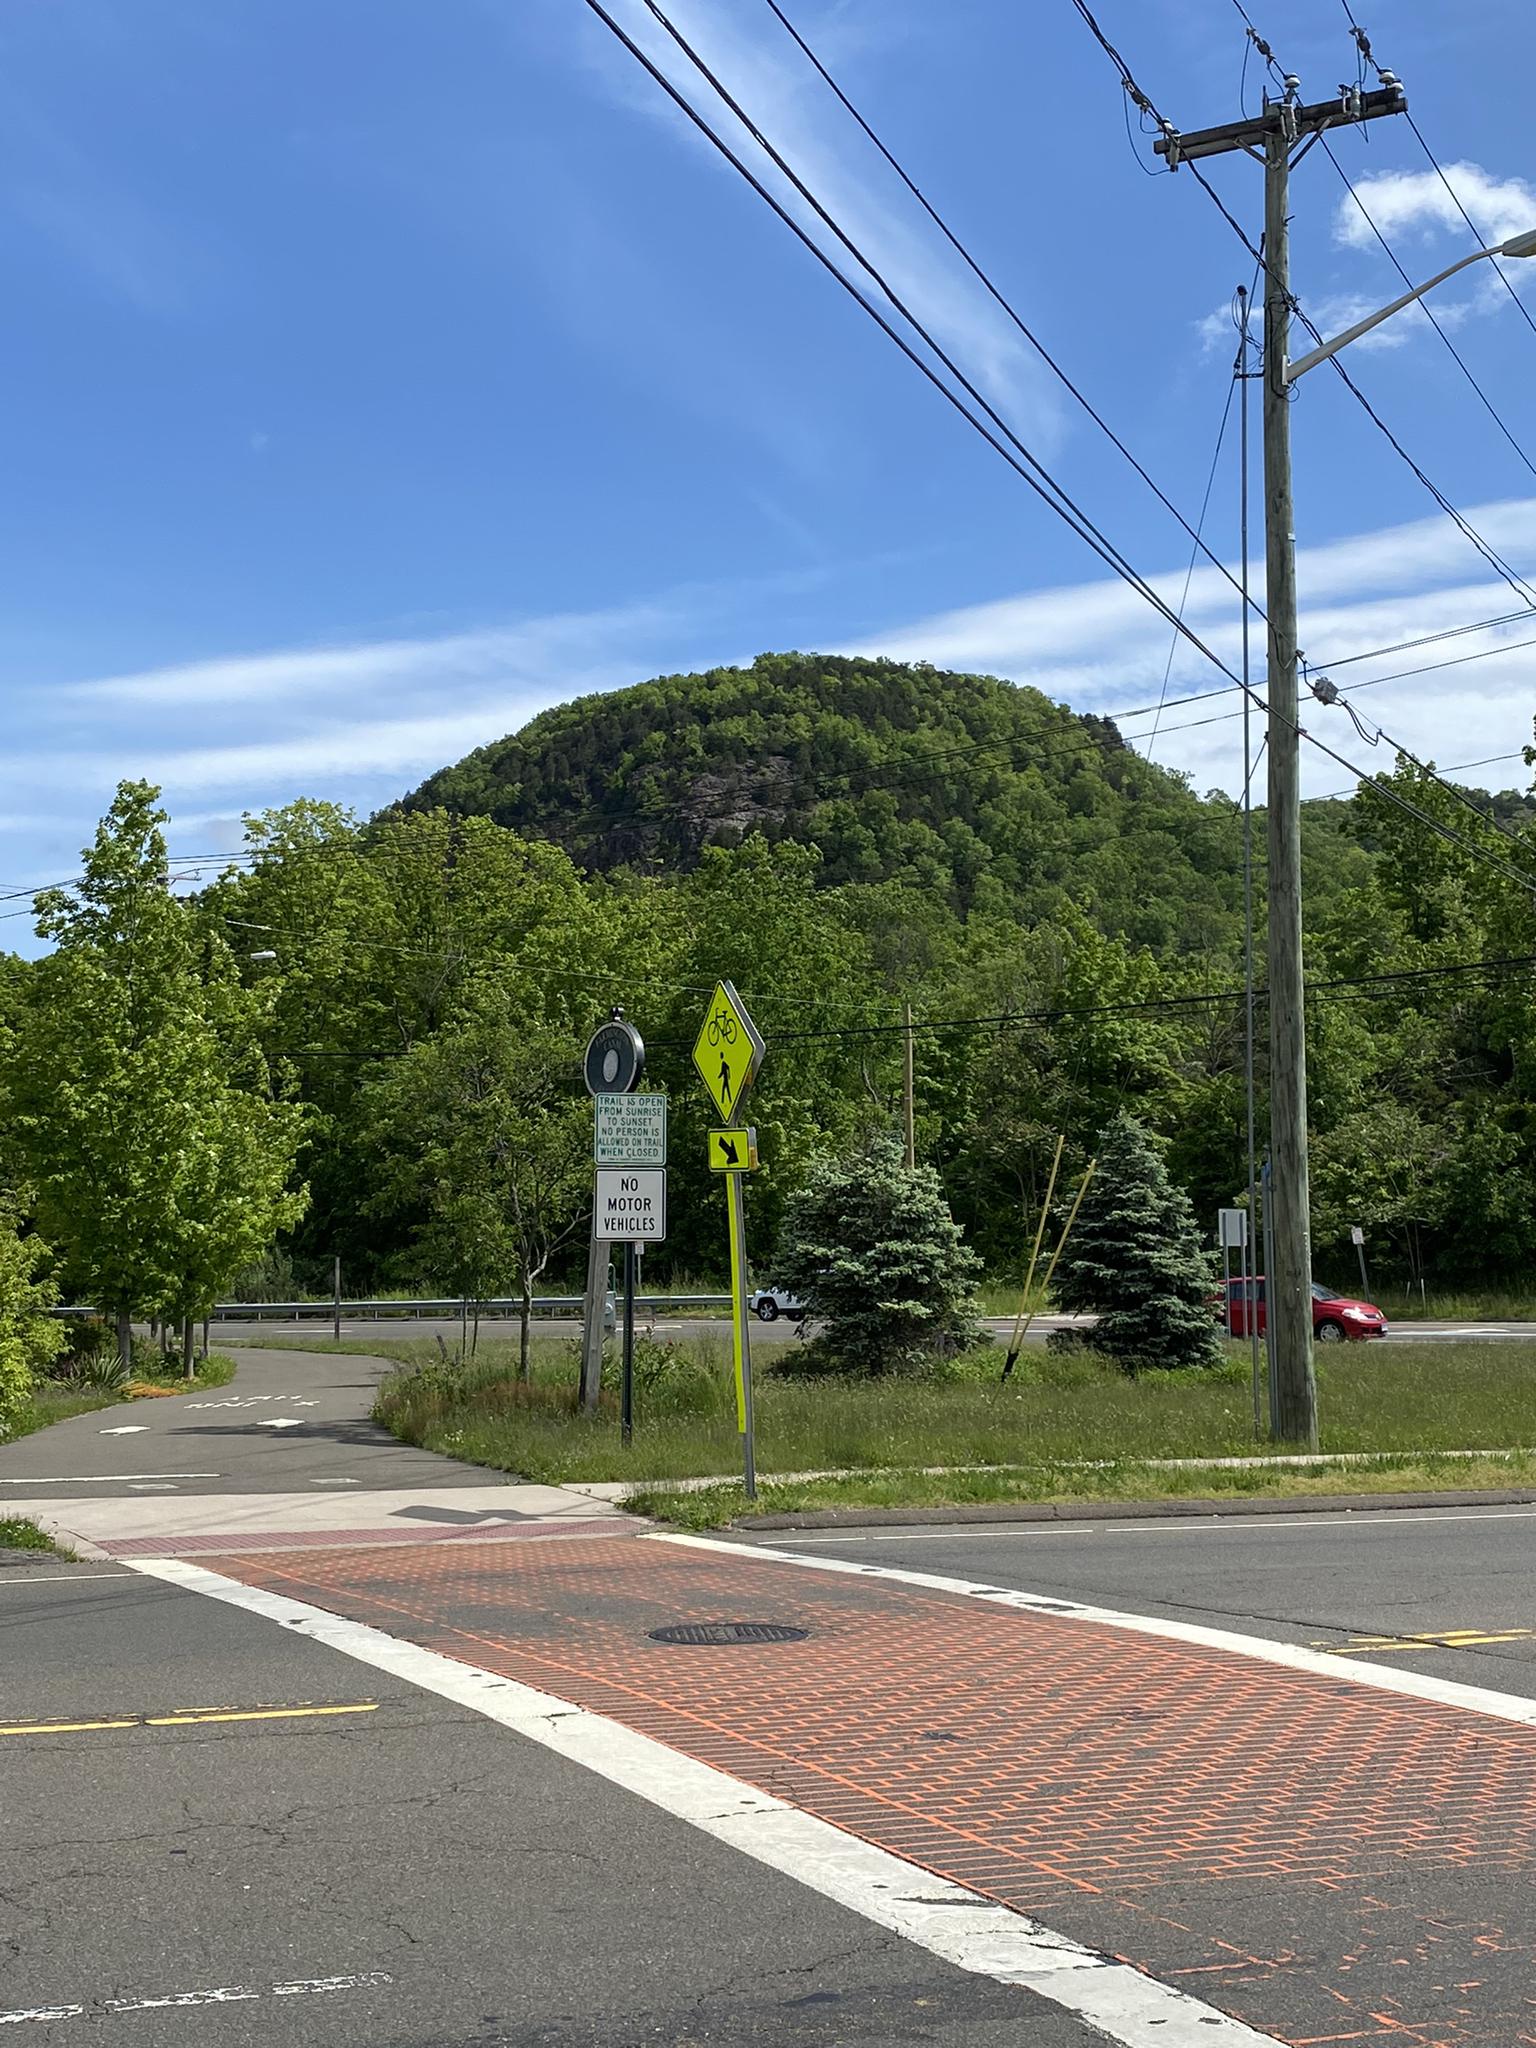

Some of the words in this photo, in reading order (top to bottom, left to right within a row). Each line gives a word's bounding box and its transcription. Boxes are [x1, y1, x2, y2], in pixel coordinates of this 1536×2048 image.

[599, 1096, 623, 1106] TRAIL
[627, 1097, 636, 1106] IS
[639, 1097, 663, 1106] OPEN
[599, 1106, 622, 1116] FROM
[625, 1106, 662, 1116] SUNRISE
[607, 1117, 617, 1126] TO
[620, 1117, 652, 1126] SUNSET
[601, 1127, 613, 1136] NO
[616, 1127, 648, 1136] PERSON
[651, 1128, 659, 1136] IS
[598, 1137, 629, 1146] ALLOWED
[632, 1137, 641, 1146] ON
[644, 1138, 663, 1147] TRAIL
[600, 1147, 623, 1156] WHEN
[626, 1147, 658, 1157] CLOSED
[621, 1178, 639, 1192] NO
[607, 1197, 652, 1211] MOTOR
[604, 1217, 655, 1231] VEHICLES
